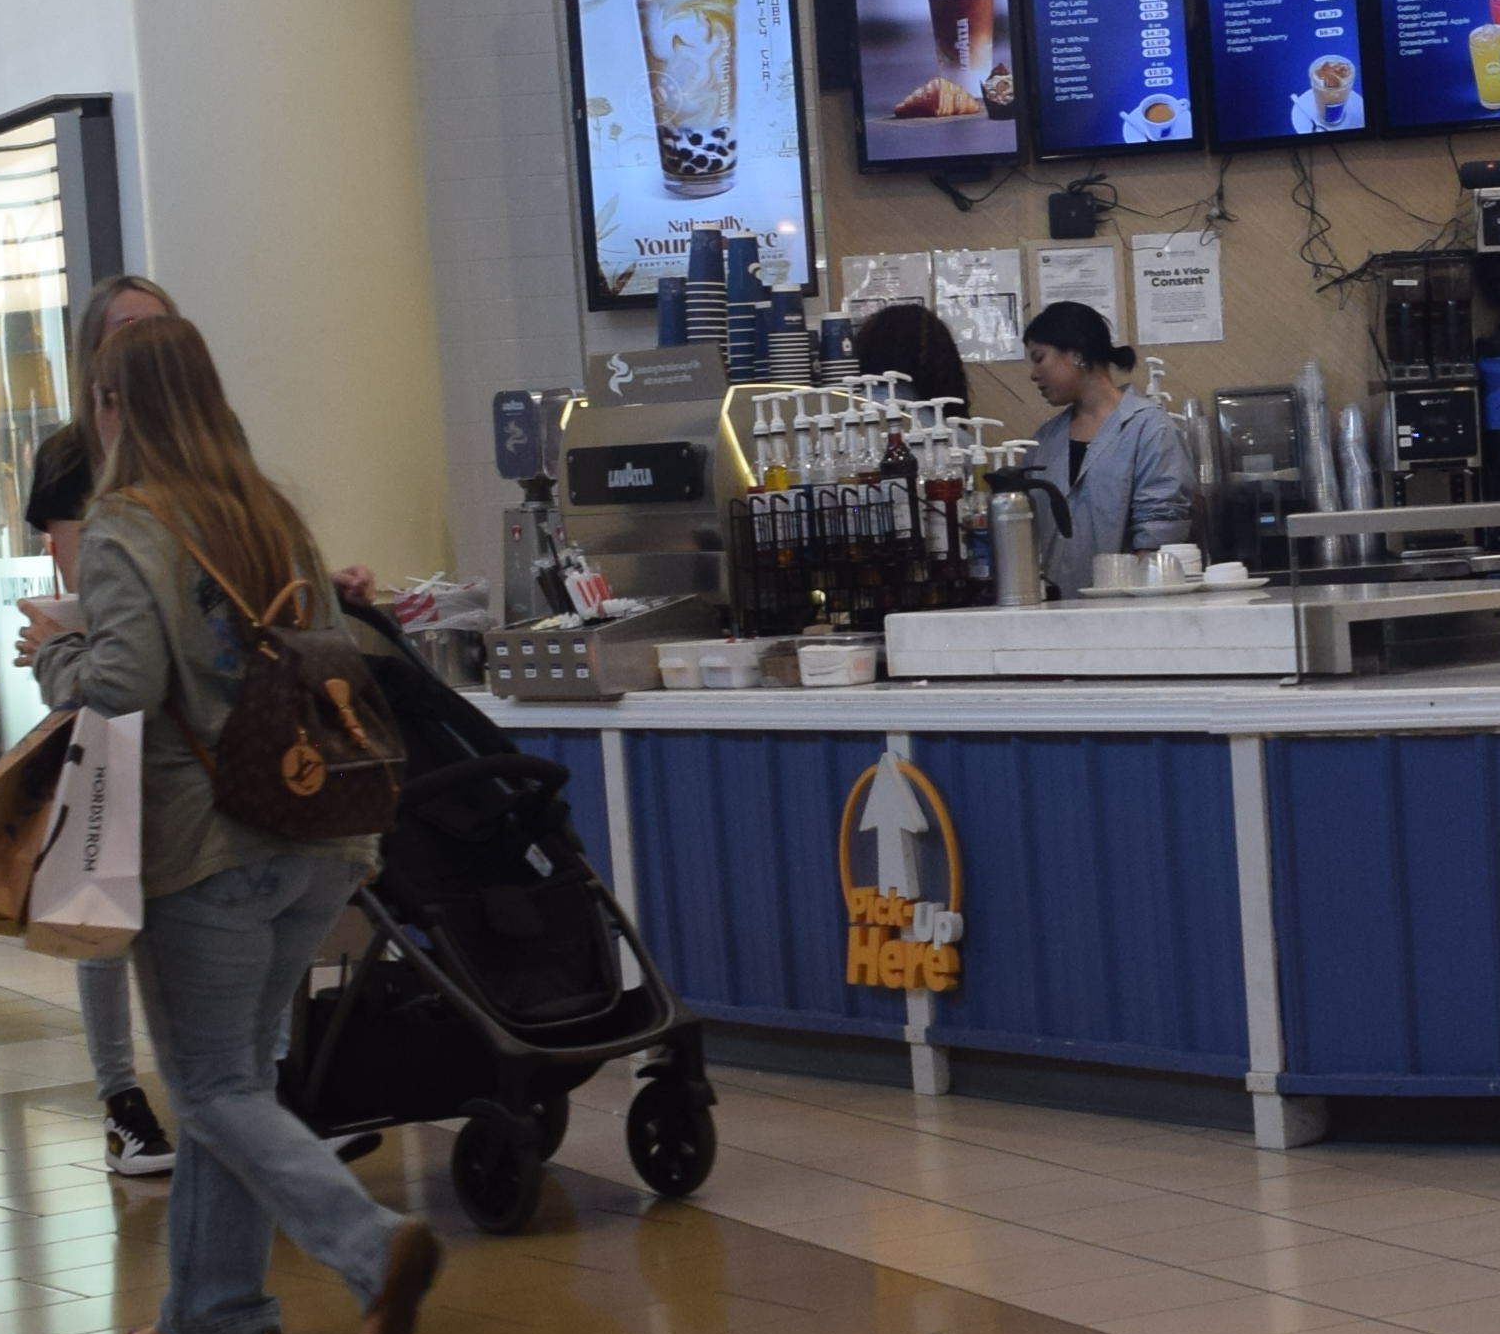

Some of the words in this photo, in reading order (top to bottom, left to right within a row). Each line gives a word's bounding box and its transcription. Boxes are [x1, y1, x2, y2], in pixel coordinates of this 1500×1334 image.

[634, 237, 691, 256] Your
[1143, 269, 1172, 277] Photo
[1184, 267, 1210, 276] Video
[1151, 275, 1204, 287] Consent
[84, 766, 106, 873] NORDSTROM
[847, 925, 962, 992] Here
